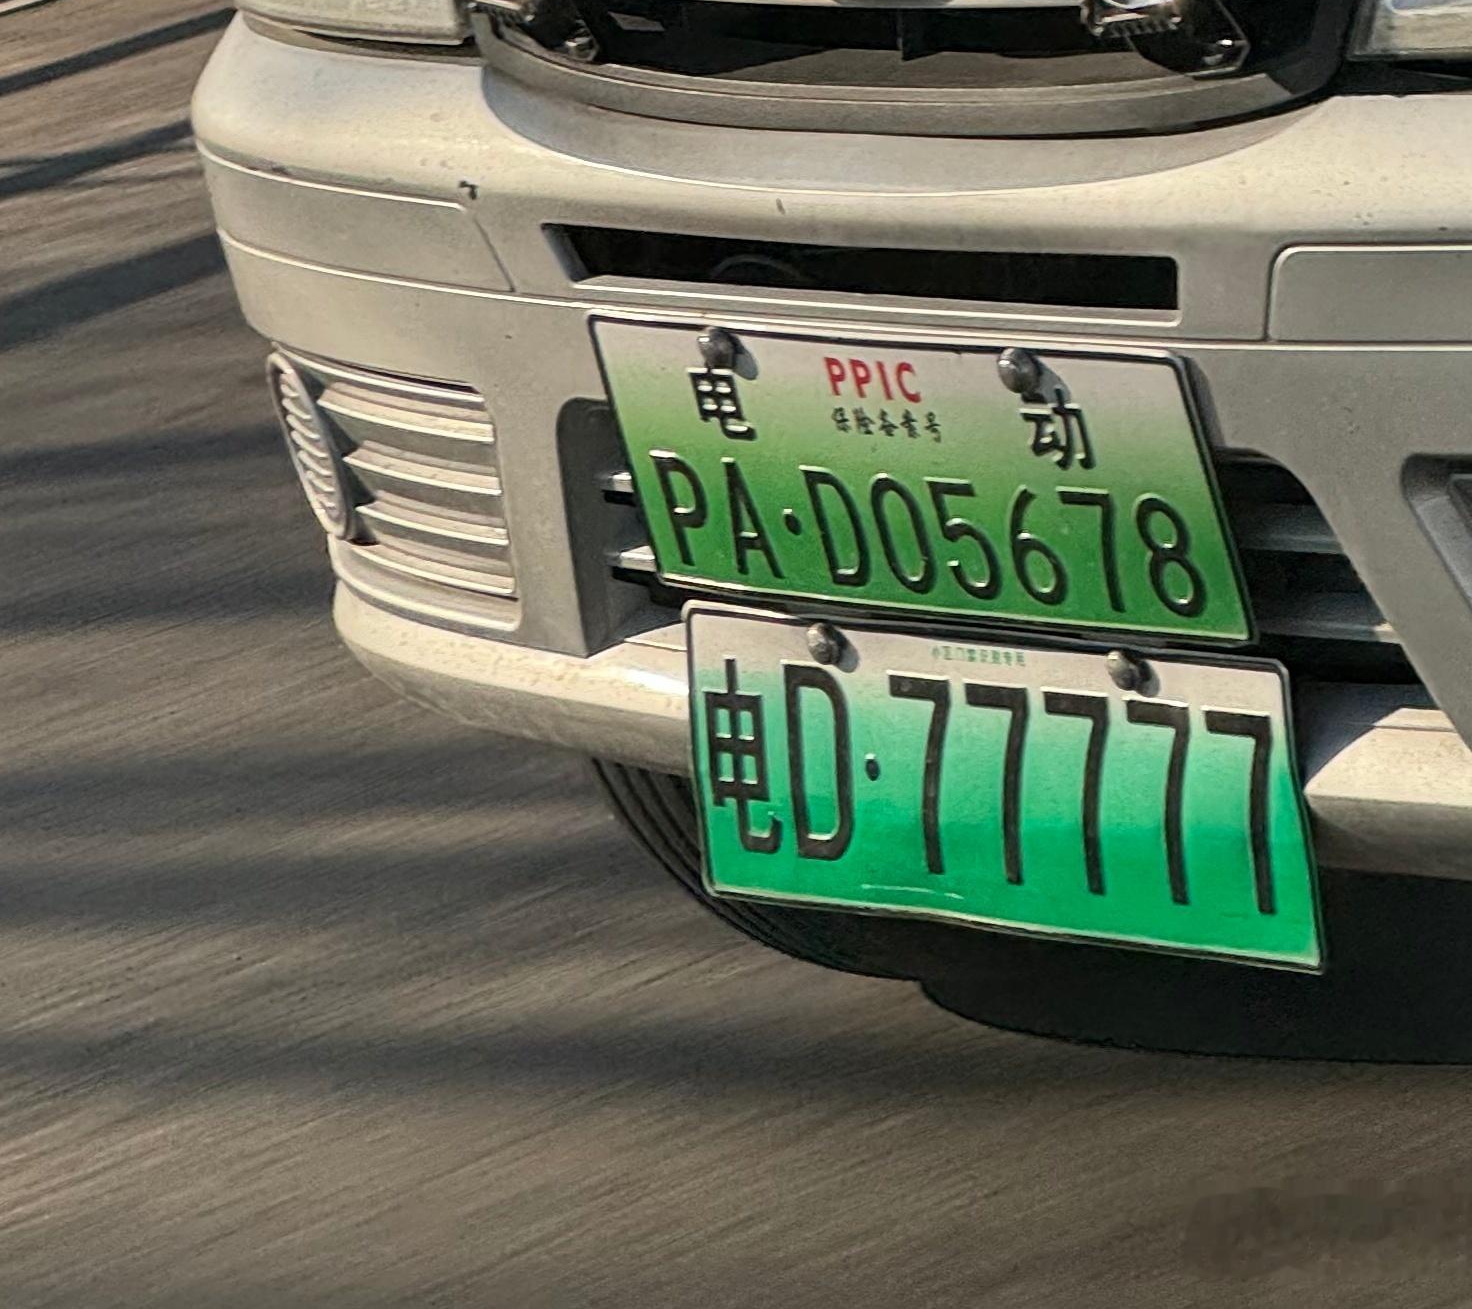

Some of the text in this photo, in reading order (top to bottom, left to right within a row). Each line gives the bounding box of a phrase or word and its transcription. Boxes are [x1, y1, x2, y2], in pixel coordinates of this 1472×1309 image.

[823, 356, 922, 403] PPIC
[687, 365, 1097, 471] 电 动
